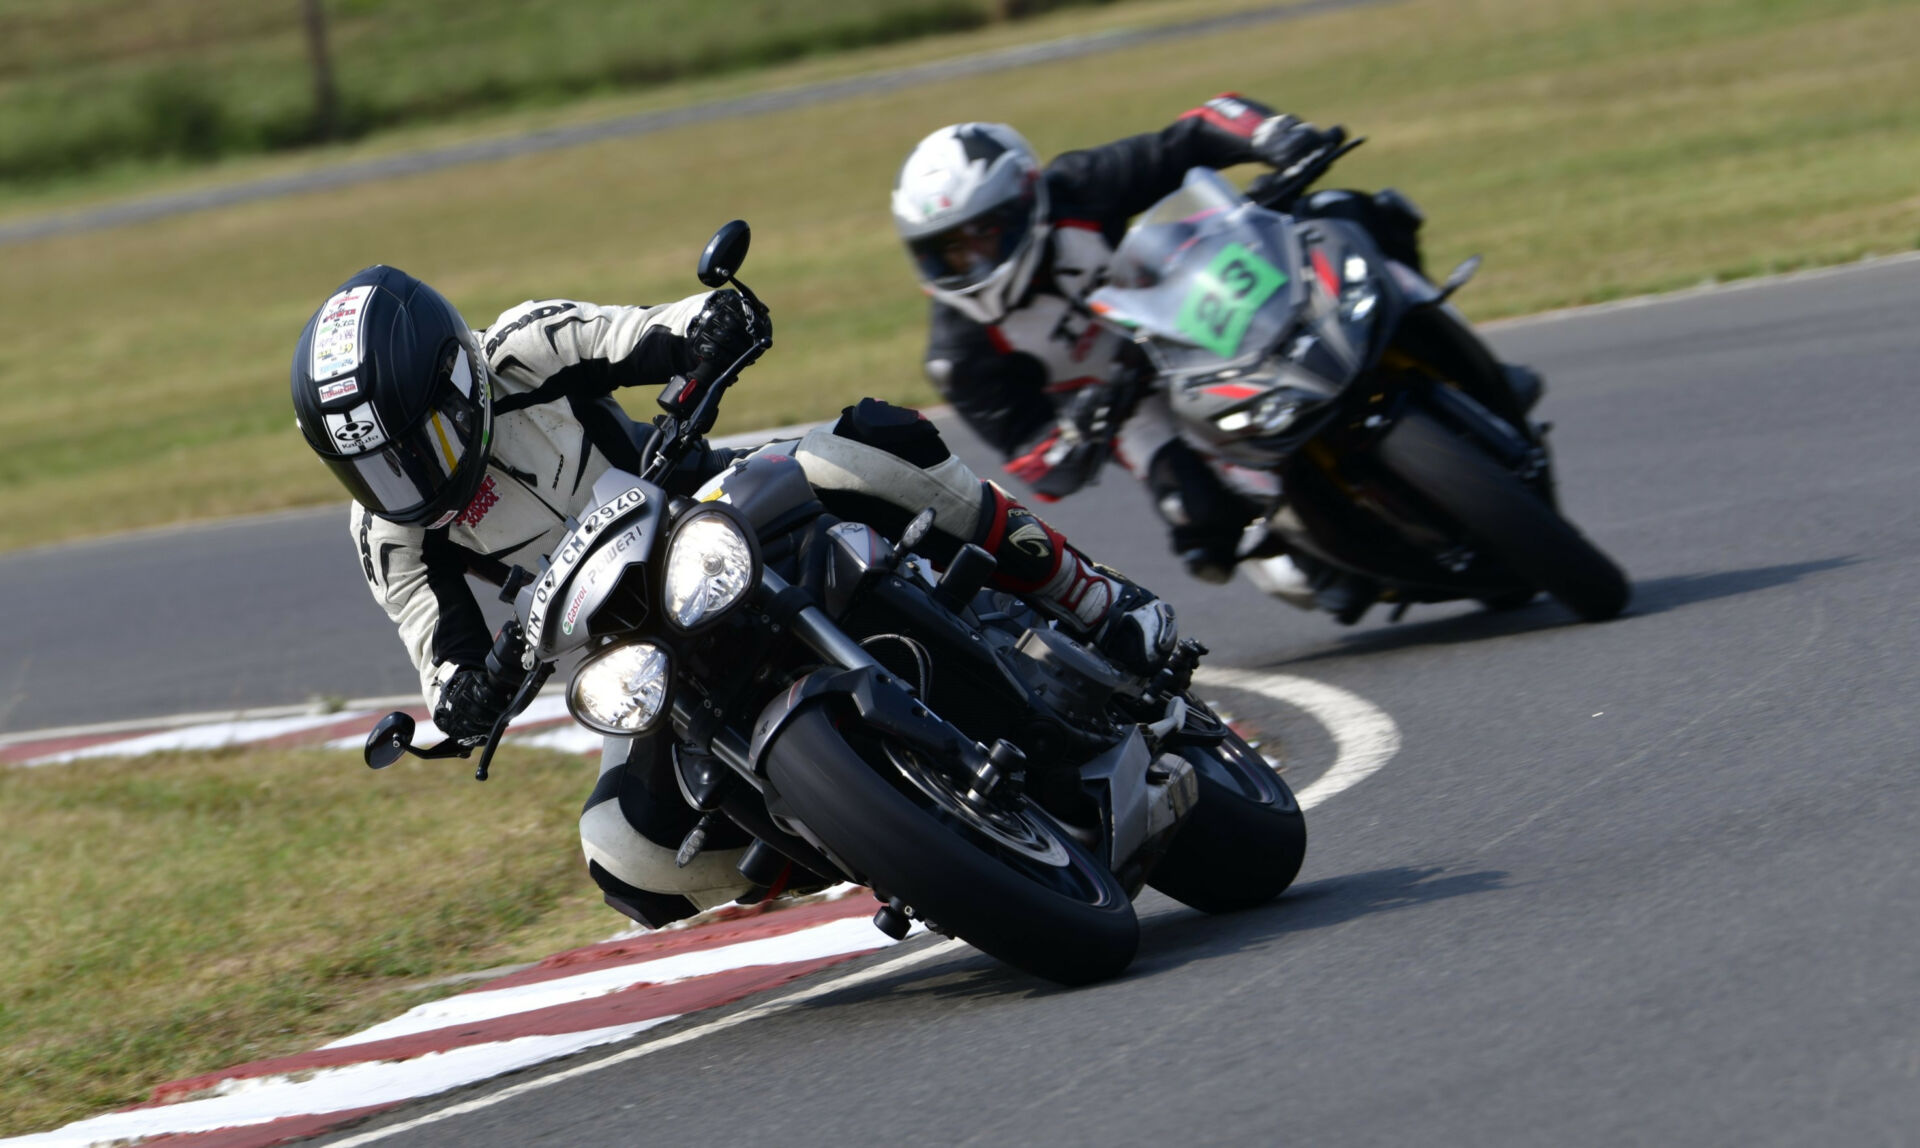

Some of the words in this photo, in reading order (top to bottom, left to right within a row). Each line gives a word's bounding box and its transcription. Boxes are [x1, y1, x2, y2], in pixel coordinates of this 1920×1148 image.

[1194, 257, 1258, 339] 23
[527, 611, 543, 640] TN
[536, 569, 556, 604] 07
[562, 535, 585, 565] CM
[586, 490, 643, 532] 2940
[567, 586, 588, 624] Castrol
